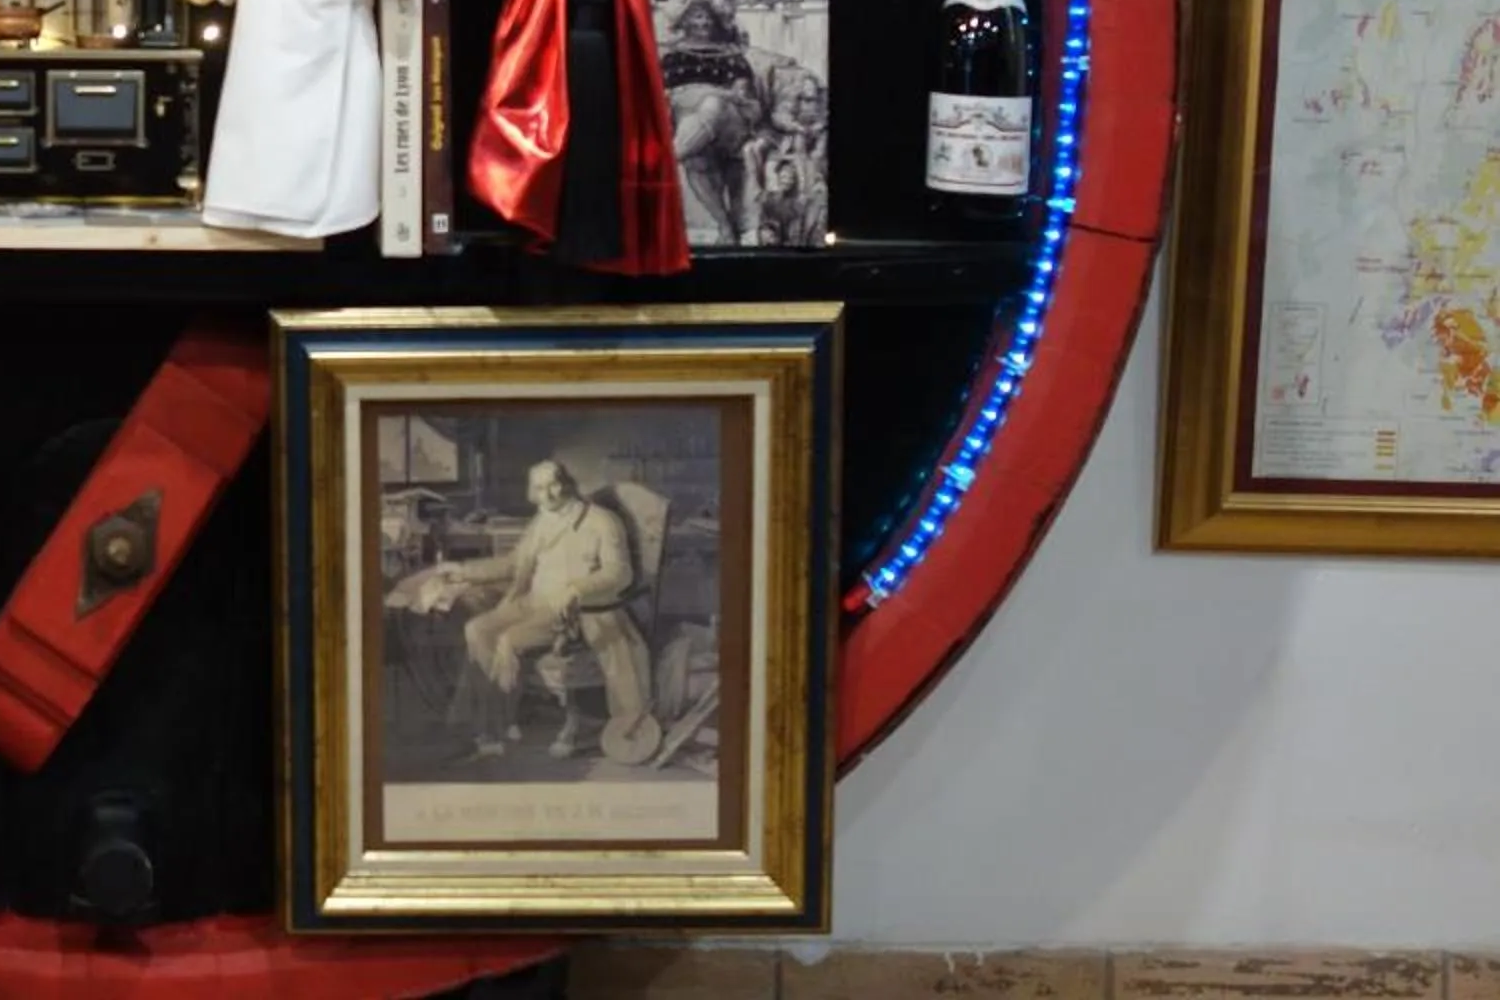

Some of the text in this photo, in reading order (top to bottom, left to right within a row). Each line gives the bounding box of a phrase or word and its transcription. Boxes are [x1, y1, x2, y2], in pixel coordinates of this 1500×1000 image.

[394, 65, 410, 97] Lyon
[394, 101, 409, 117] de
[394, 153, 409, 173] Les
